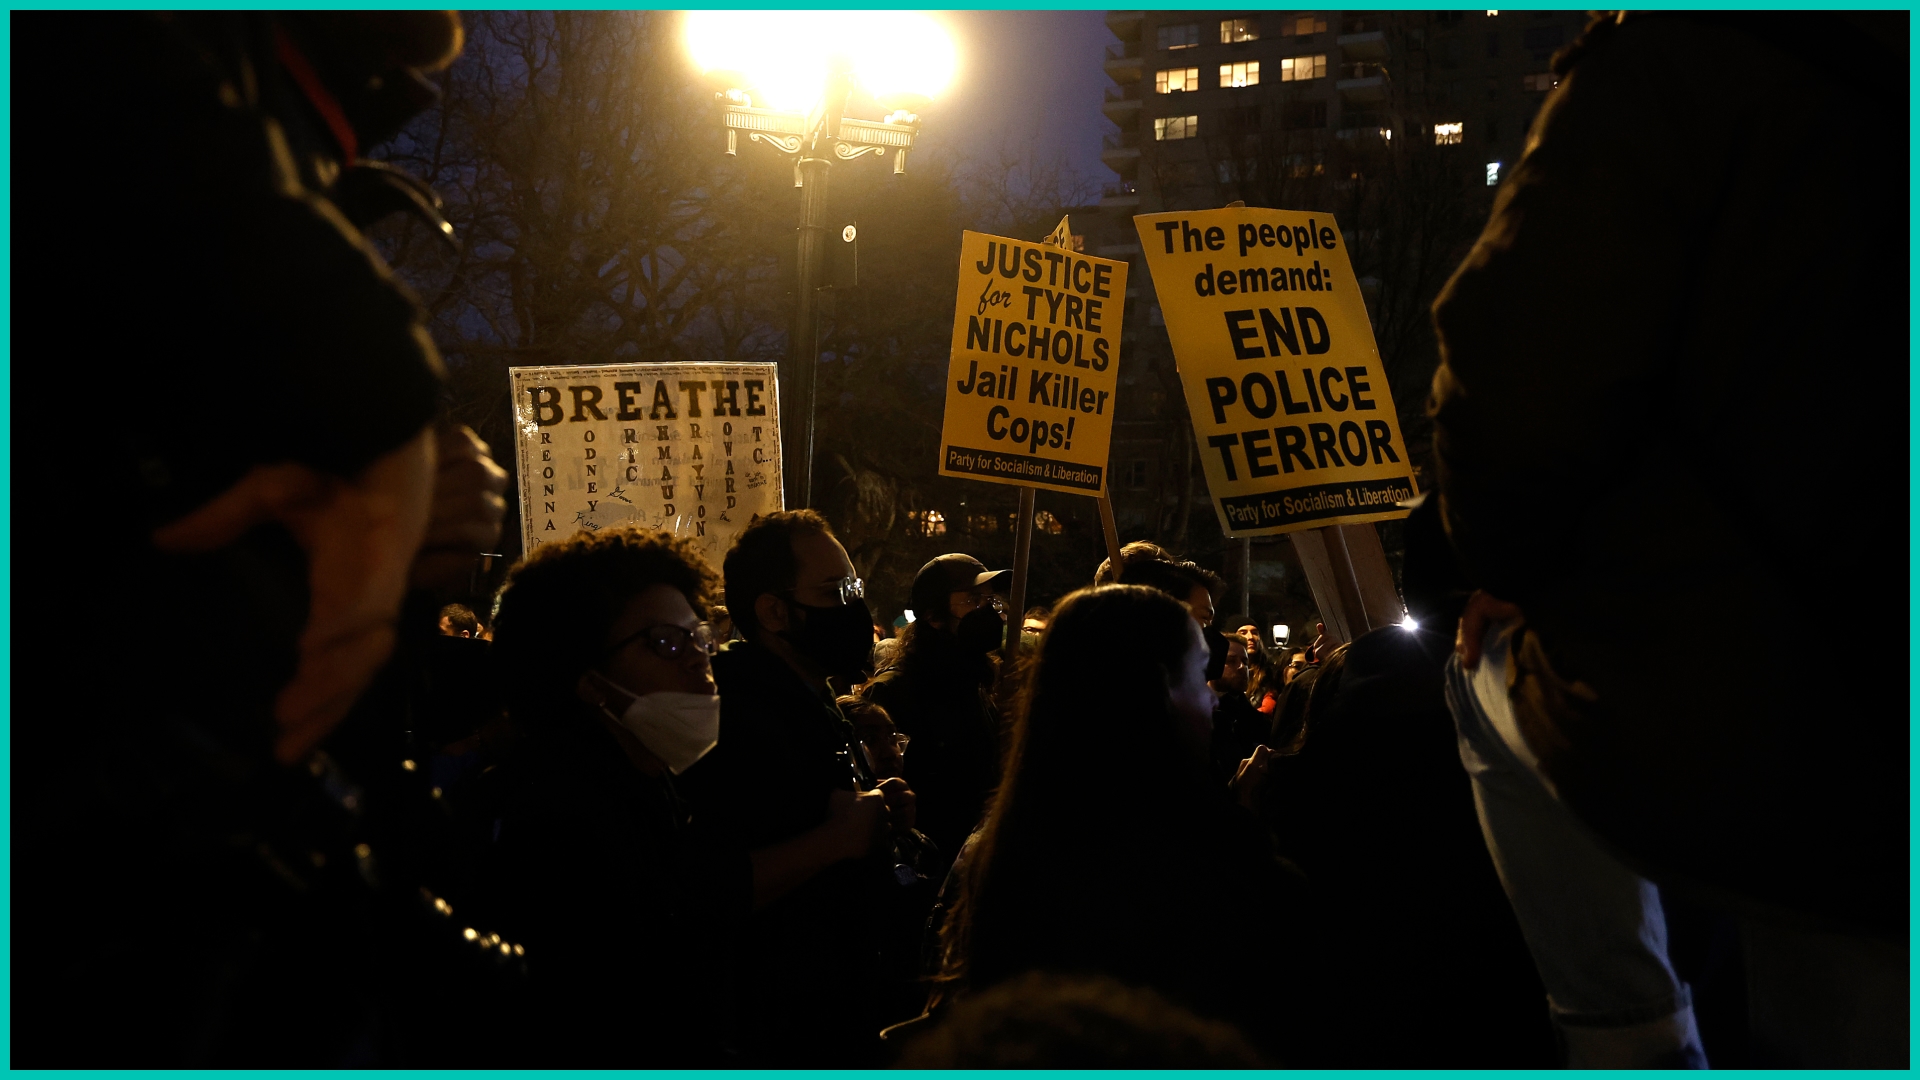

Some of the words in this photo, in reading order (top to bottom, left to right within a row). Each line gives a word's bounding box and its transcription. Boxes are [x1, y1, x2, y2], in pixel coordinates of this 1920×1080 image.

[1155, 221, 1225, 254] The
[1238, 218, 1337, 257] people
[976, 241, 1112, 298] JUSTICE
[1194, 260, 1333, 297] demand:
[977, 278, 1012, 315] for
[1022, 285, 1103, 333] TYRE
[966, 315, 1110, 372] NICHOLS
[1224, 306, 1331, 361] END
[527, 379, 766, 427] BREATHE
[956, 360, 1019, 401] Jail
[1028, 369, 1109, 415] Killer
[1205, 366, 1377, 424] POLICE
[986, 405, 1075, 454] Cops!
[1207, 419, 1401, 482] TERROR
[949, 451, 975, 470] Party
[977, 454, 992, 469] for
[994, 457, 1043, 476] Socialism
[1044, 463, 1050, 477] &
[1052, 464, 1099, 485] Liberation
[571, 511, 602, 531] King
[1226, 503, 1260, 525] Party
[1261, 501, 1281, 518] for
[1285, 490, 1346, 515] Socialism
[1347, 488, 1356, 507] &
[1356, 485, 1411, 506] Liberation
